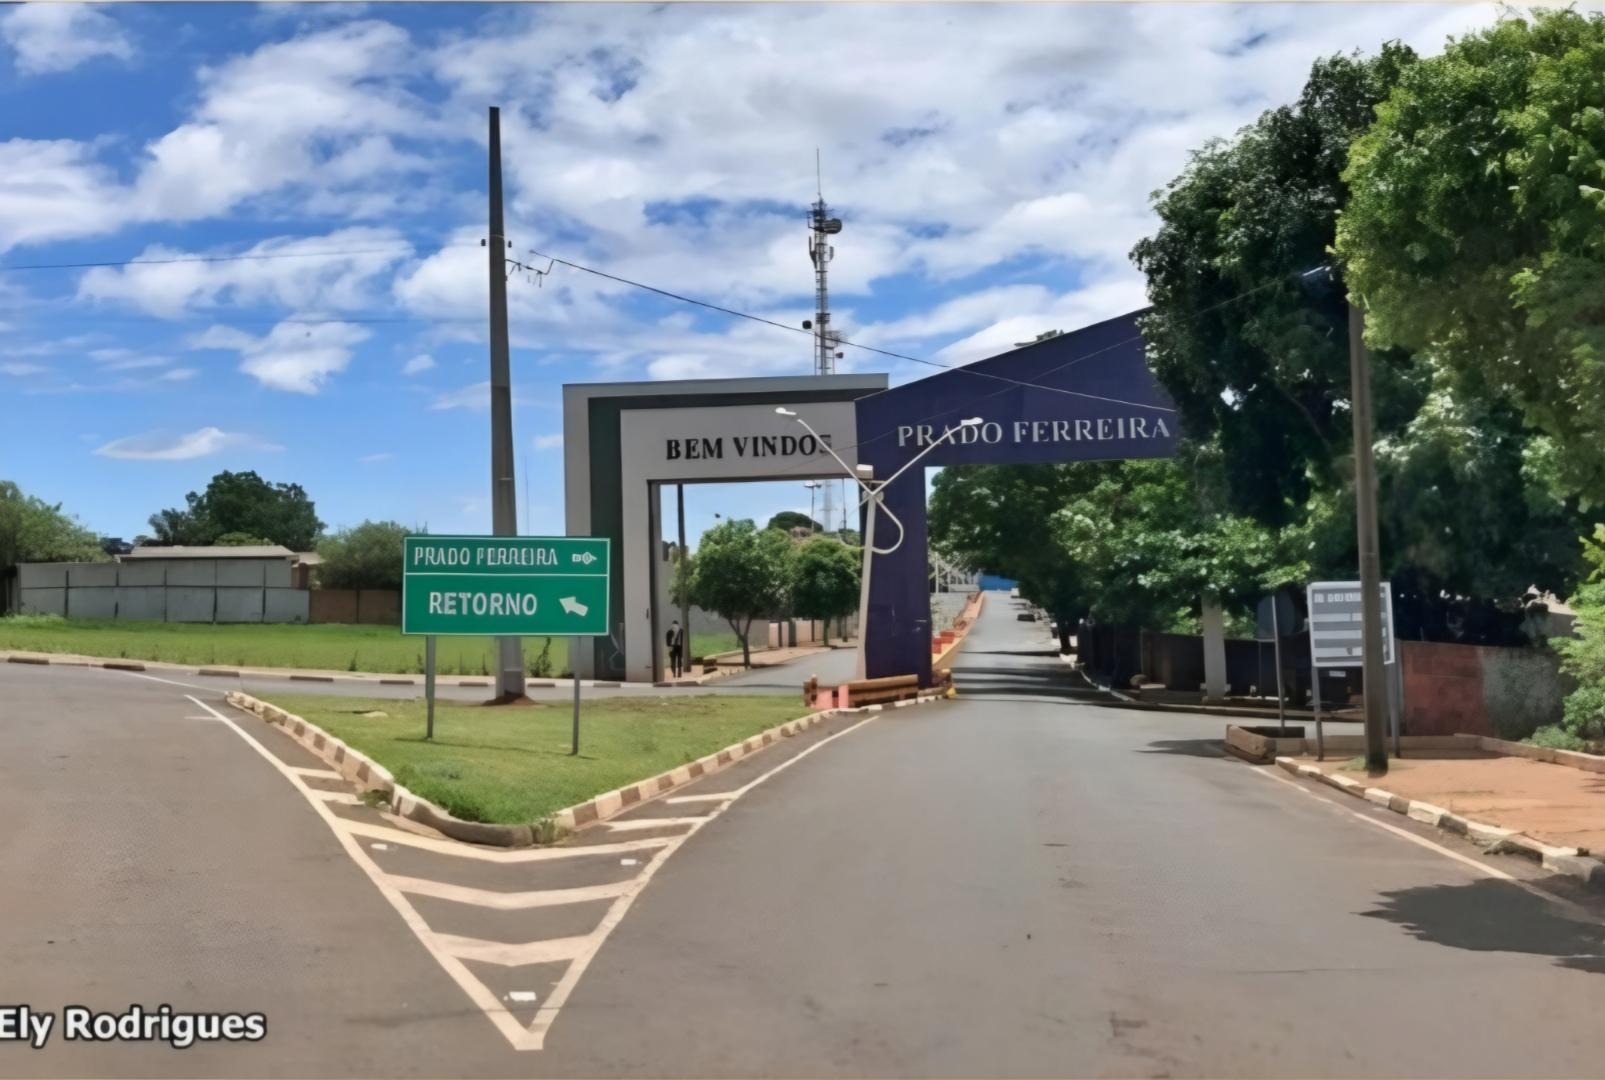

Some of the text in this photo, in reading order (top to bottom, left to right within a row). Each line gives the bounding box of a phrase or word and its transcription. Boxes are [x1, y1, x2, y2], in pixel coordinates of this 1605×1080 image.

[898, 417, 1171, 447] PRADO FERREIRA
[666, 437, 723, 460] BEM
[414, 547, 471, 566] PRADO
[428, 591, 538, 616] RETORNO
